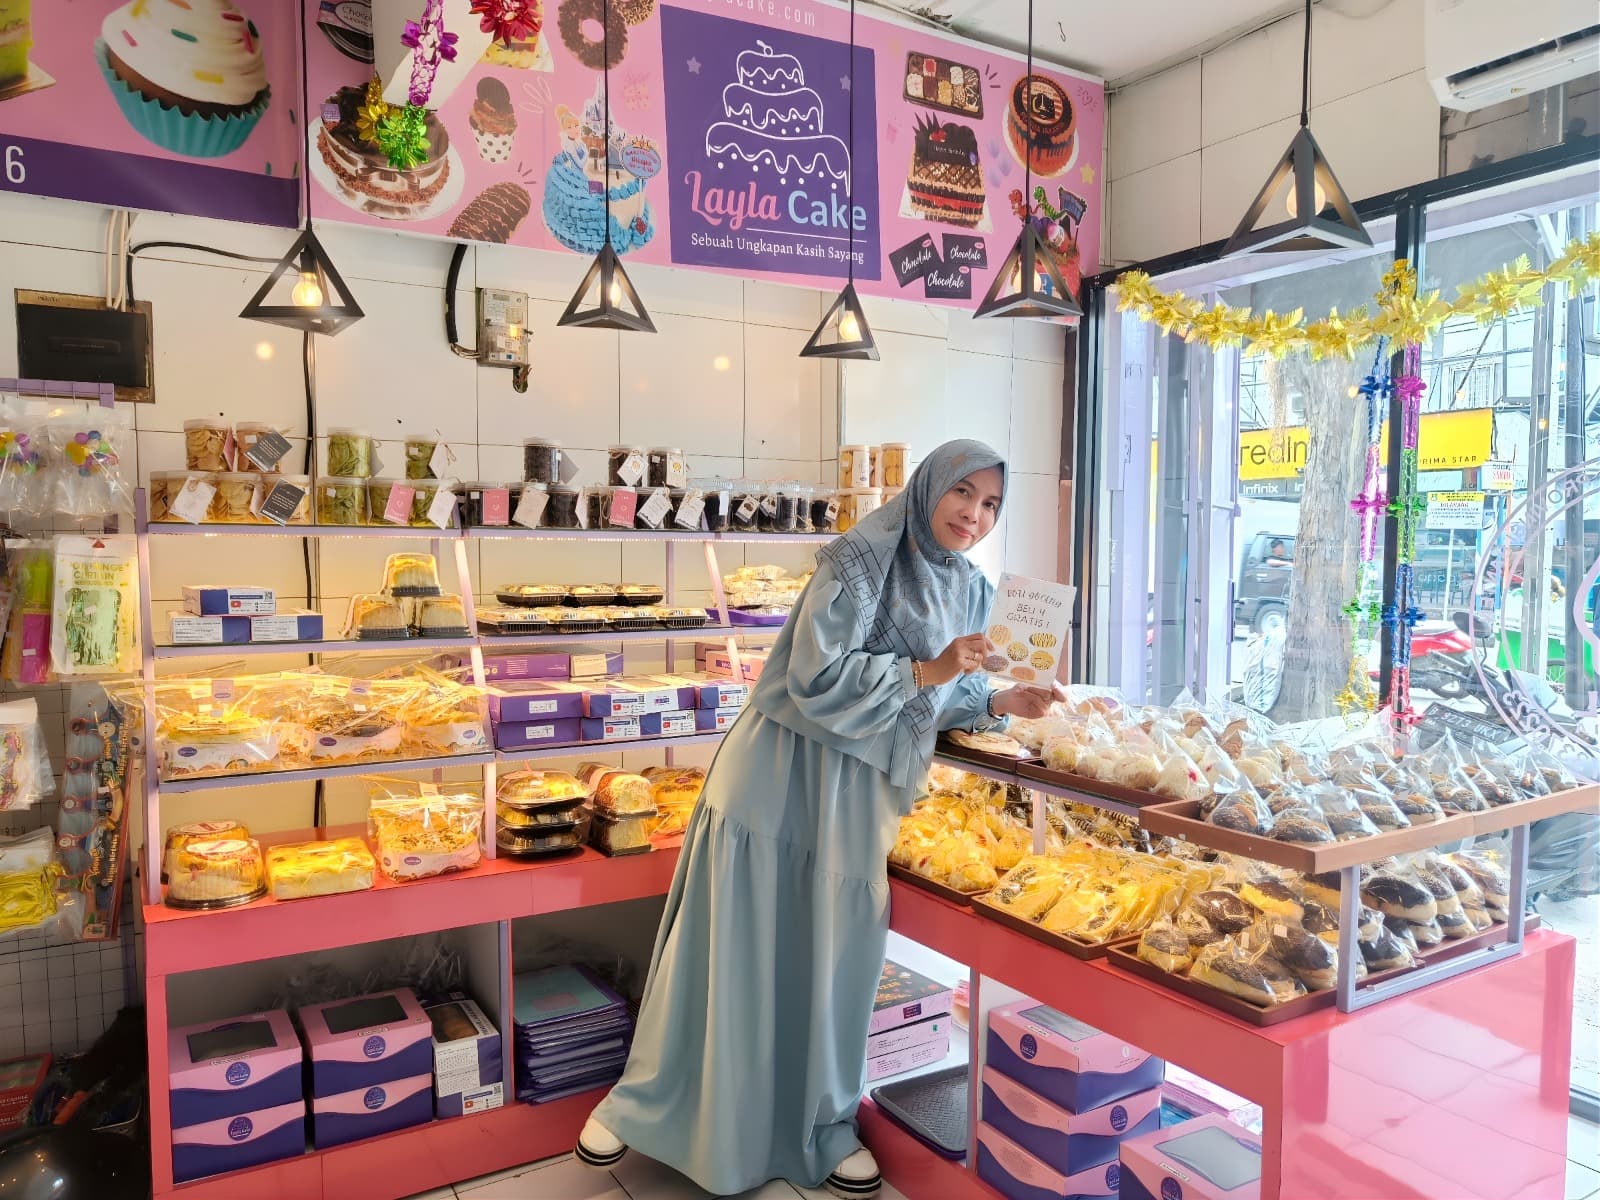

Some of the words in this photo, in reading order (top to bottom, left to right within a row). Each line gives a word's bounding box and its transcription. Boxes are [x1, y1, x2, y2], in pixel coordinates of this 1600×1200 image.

[6, 145, 26, 184] 6
[684, 170, 780, 229] Layla
[788, 190, 867, 231] Cake
[691, 232, 734, 250] Sebuah
[736, 237, 793, 256] Ungkapan
[796, 243, 826, 258] Kasih
[827, 246, 864, 264] Sayang
[949, 244, 982, 261] Chocolate
[901, 248, 932, 275] Chocolate
[927, 269, 966, 289] Chocolate
[1419, 457, 1448, 466] RIMA
[1452, 454, 1478, 464] STAR
[1242, 483, 1279, 496] Infinix
